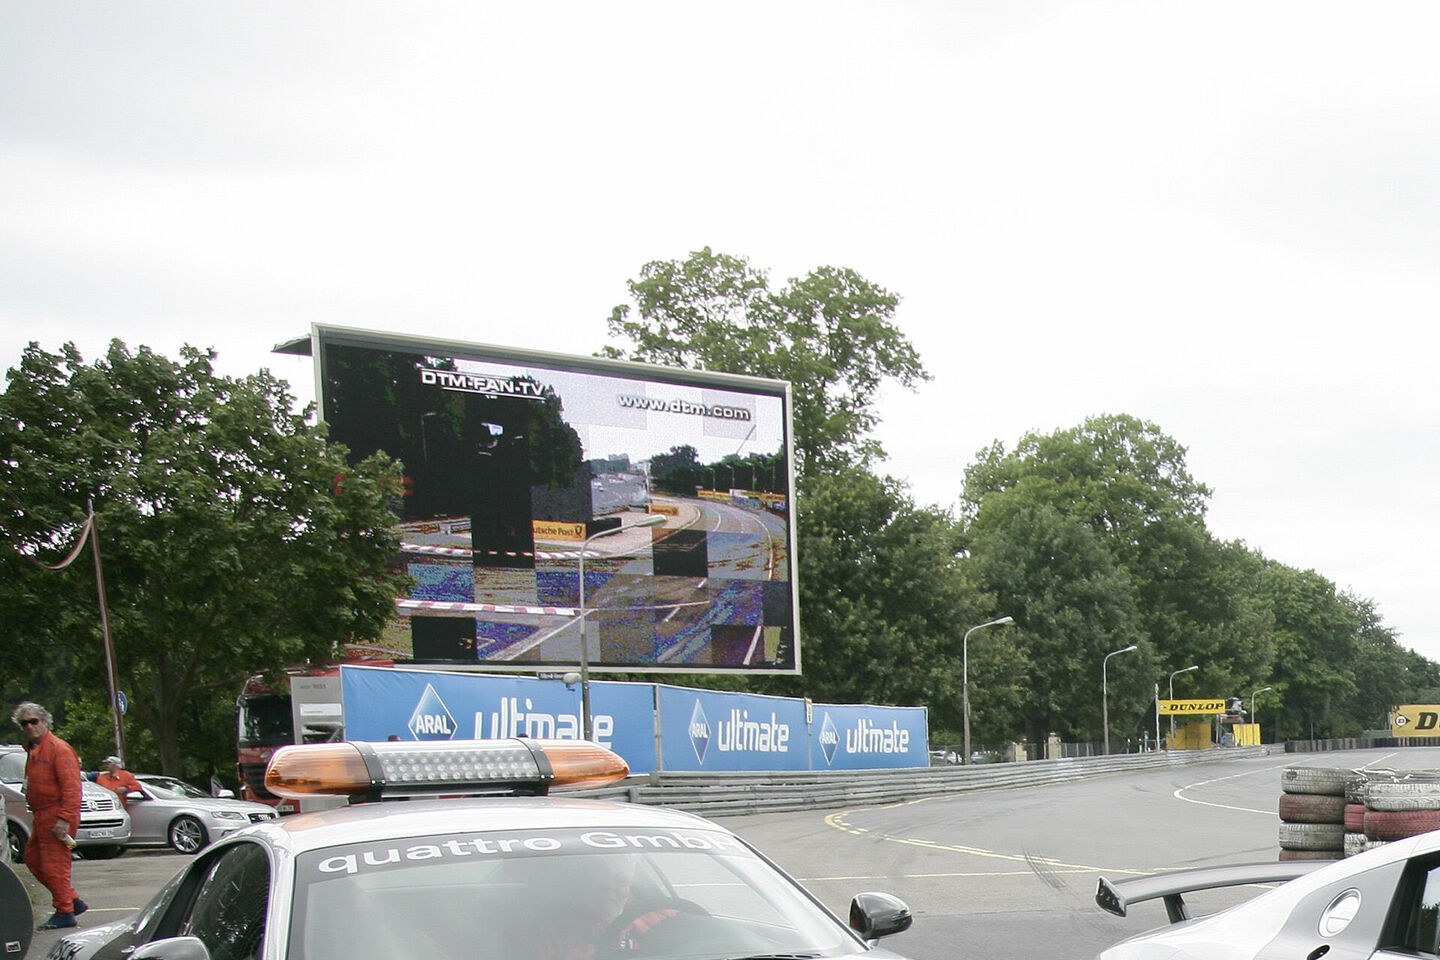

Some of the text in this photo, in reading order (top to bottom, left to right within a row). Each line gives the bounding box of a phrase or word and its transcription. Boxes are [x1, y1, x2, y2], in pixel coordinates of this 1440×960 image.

[421, 371, 544, 396] DTM-FAN-TV
[618, 396, 751, 420] www.dtm.com
[1169, 703, 1224, 711] DUNLOP
[415, 714, 452, 734] ARAL
[691, 722, 709, 738] ARAL
[718, 709, 789, 752] ultimate
[822, 719, 909, 753] ARAL ultimate
[318, 831, 749, 875] quattro GmbH
